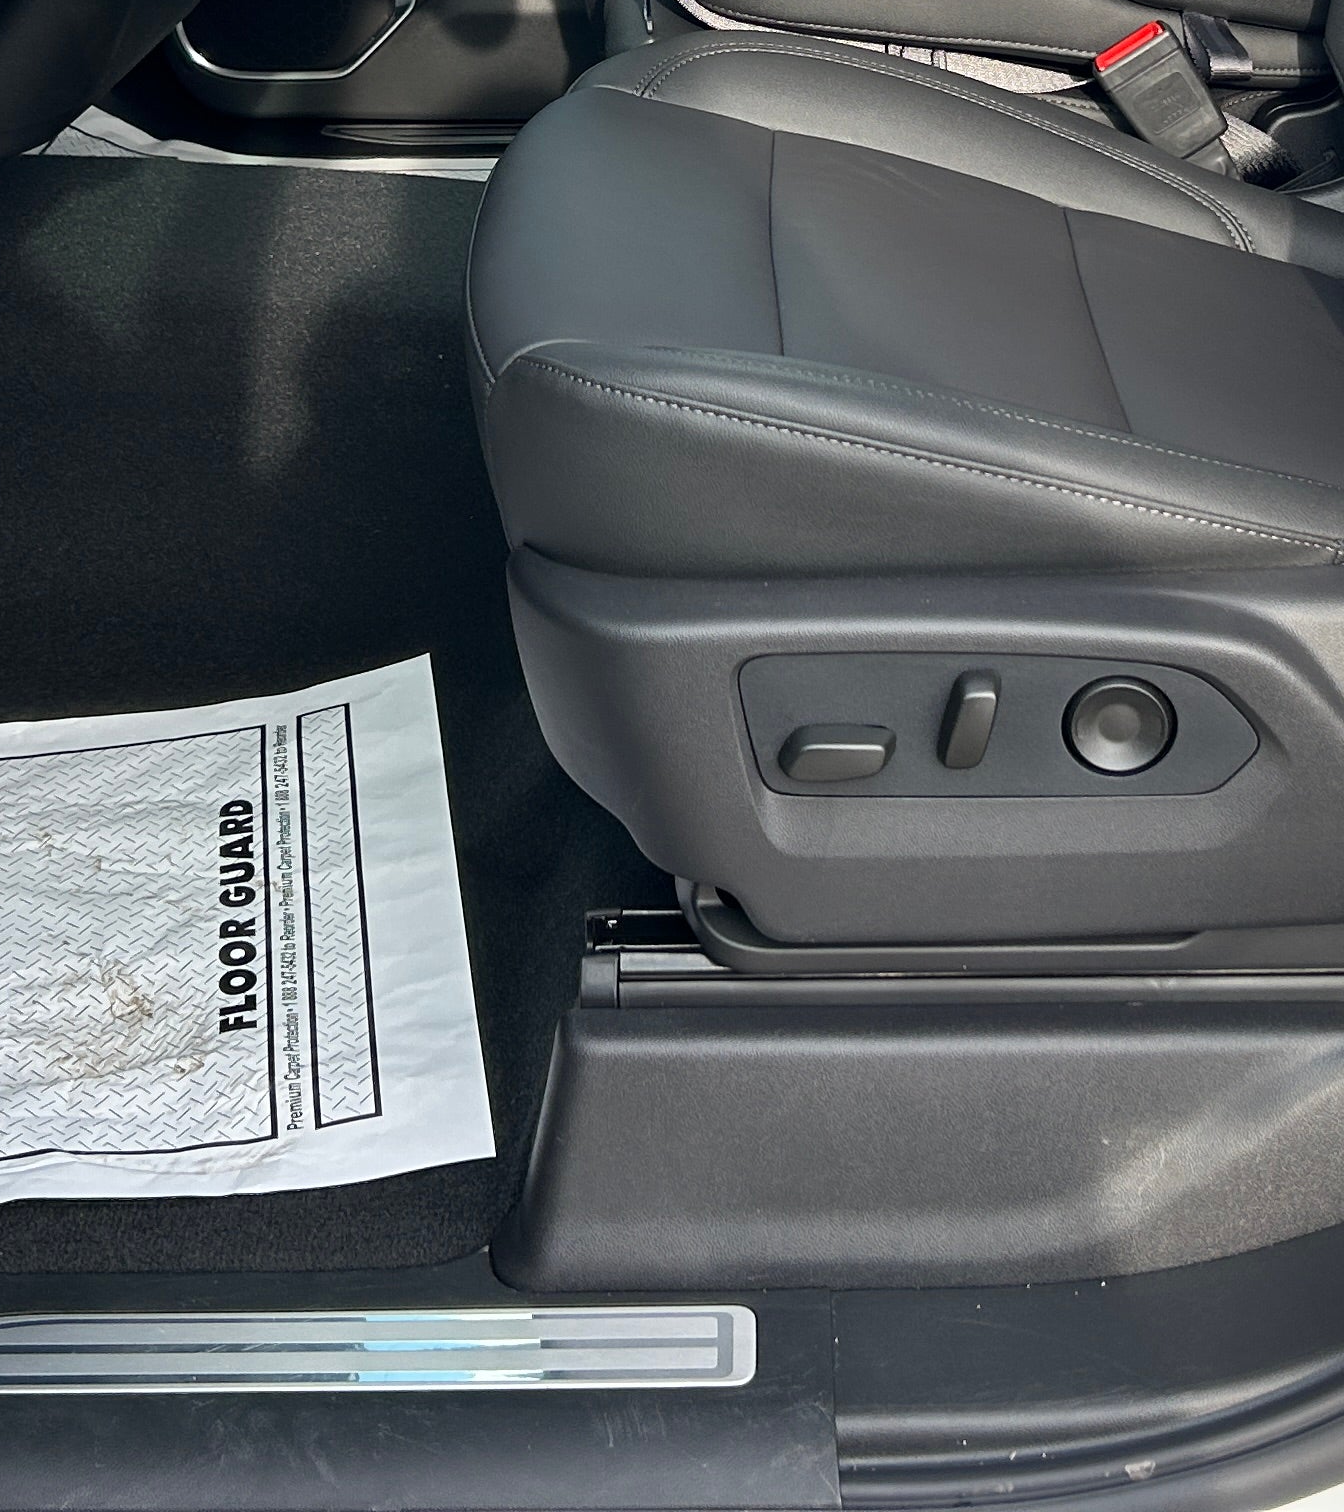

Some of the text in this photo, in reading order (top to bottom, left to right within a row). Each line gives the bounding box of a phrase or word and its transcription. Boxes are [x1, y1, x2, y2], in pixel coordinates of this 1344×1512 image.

[277, 847, 294, 870] Carpet
[219, 799, 258, 1034] FLOOR GUARD
[286, 1083, 304, 1130] Premium
